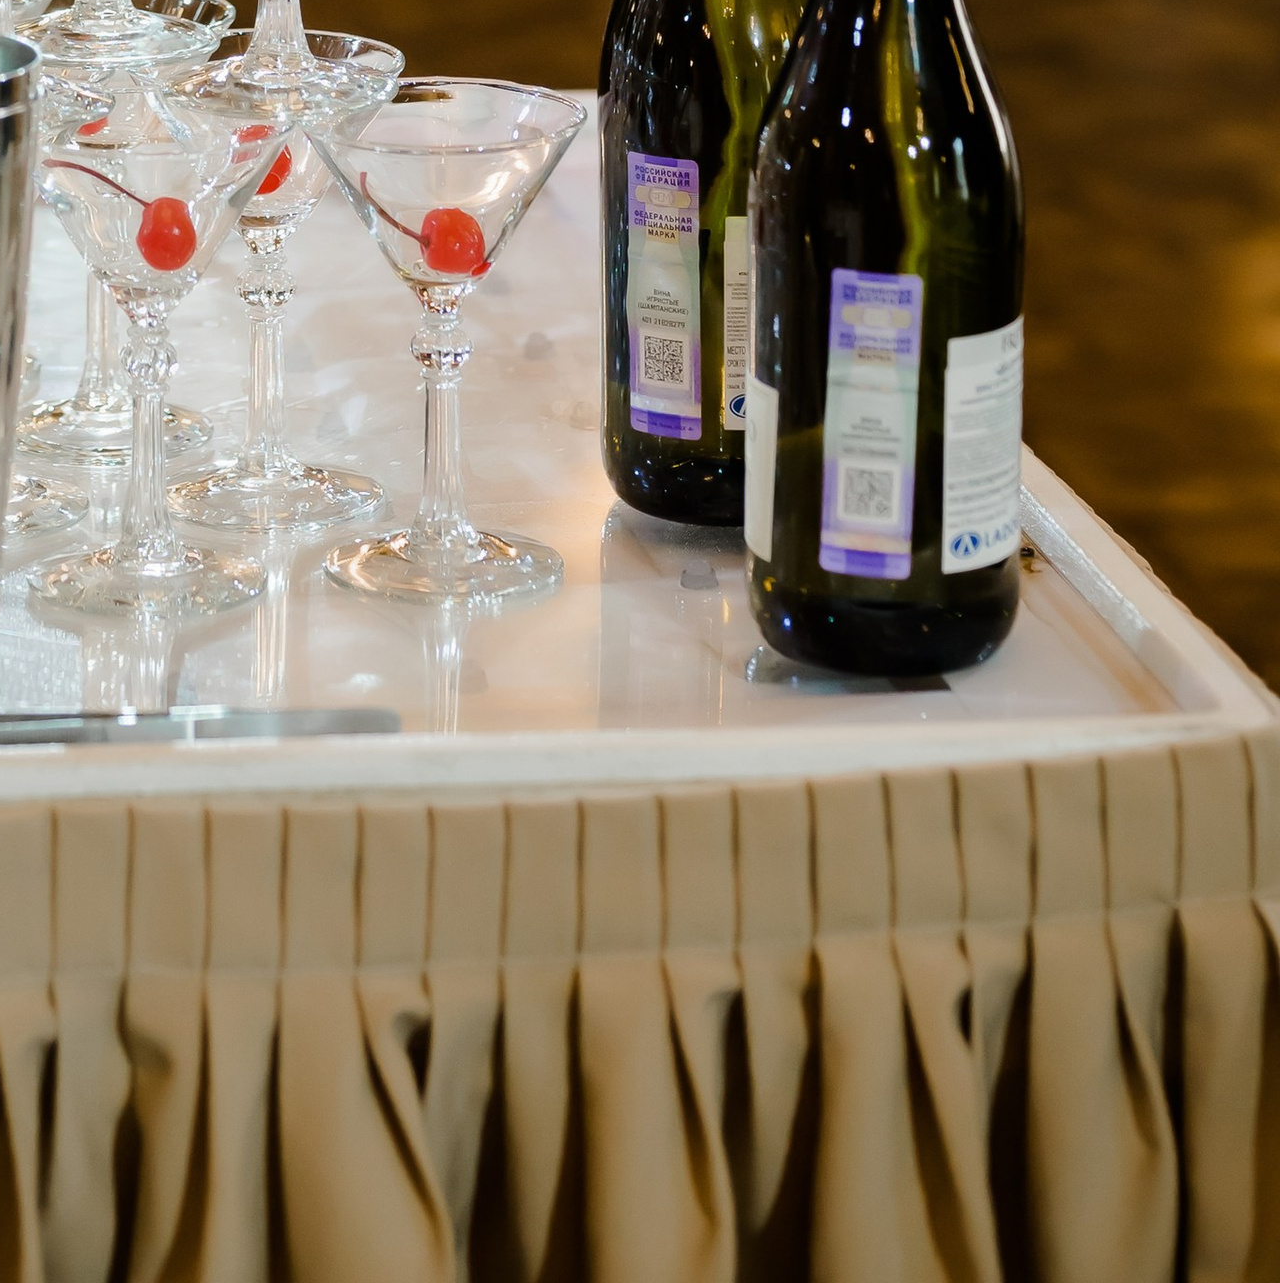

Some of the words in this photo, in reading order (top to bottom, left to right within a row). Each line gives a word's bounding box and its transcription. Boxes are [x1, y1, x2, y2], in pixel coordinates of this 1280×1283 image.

[634, 164, 690, 180] РОССИЙСКАЯ
[635, 173, 691, 187] ФЕДЕРАЦИЯ
[634, 209, 693, 225] ФЕДЕРАЛЬНАЯ
[634, 217, 693, 233] СПЕЦИАЛЬНАЯ
[647, 228, 676, 239] МАРКА
[653, 288, 671, 297] ВИНА
[646, 295, 679, 307] ИГРИСТЫЕ
